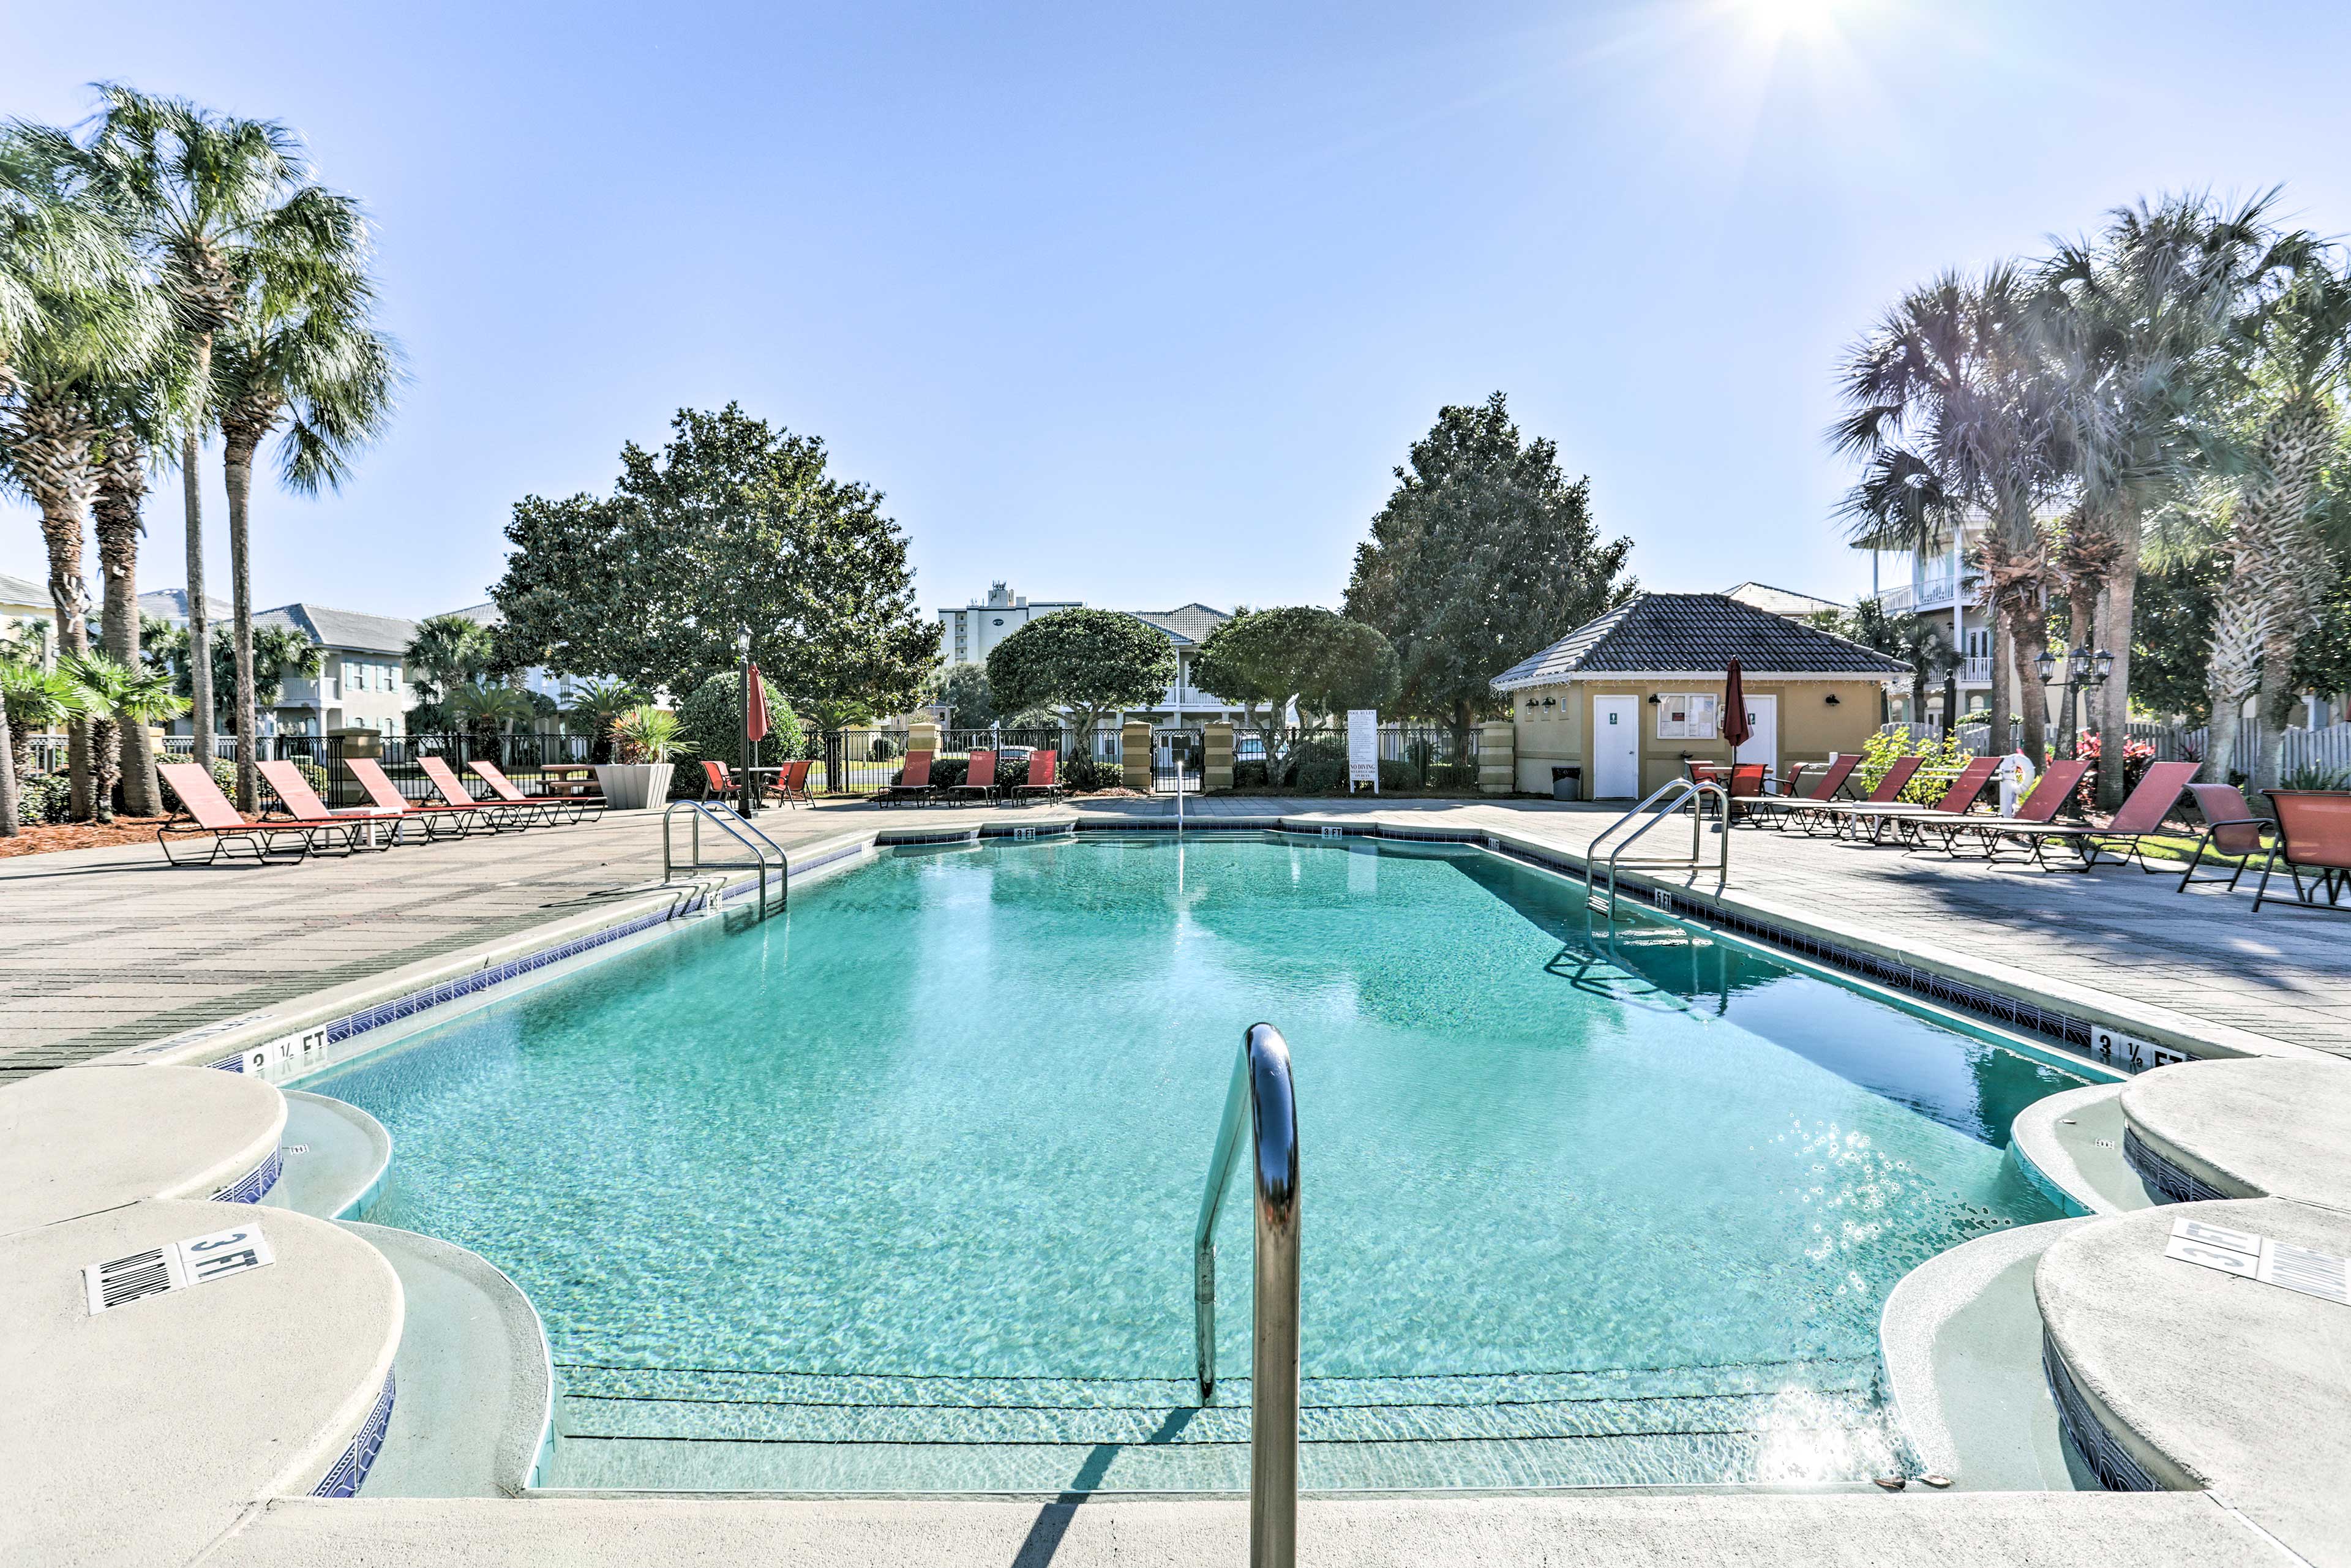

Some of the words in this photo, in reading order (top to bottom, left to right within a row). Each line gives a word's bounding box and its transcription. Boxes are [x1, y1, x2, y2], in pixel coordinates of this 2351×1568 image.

[1663, 893, 1670, 906] FT
[303, 1031, 324, 1052] FT
[2099, 1035, 2111, 1054] 3
[190, 1233, 247, 1251] 3
[2185, 1222, 2248, 1250] FT
[195, 1248, 258, 1278] FT
[2182, 1247, 2244, 1267] 3
